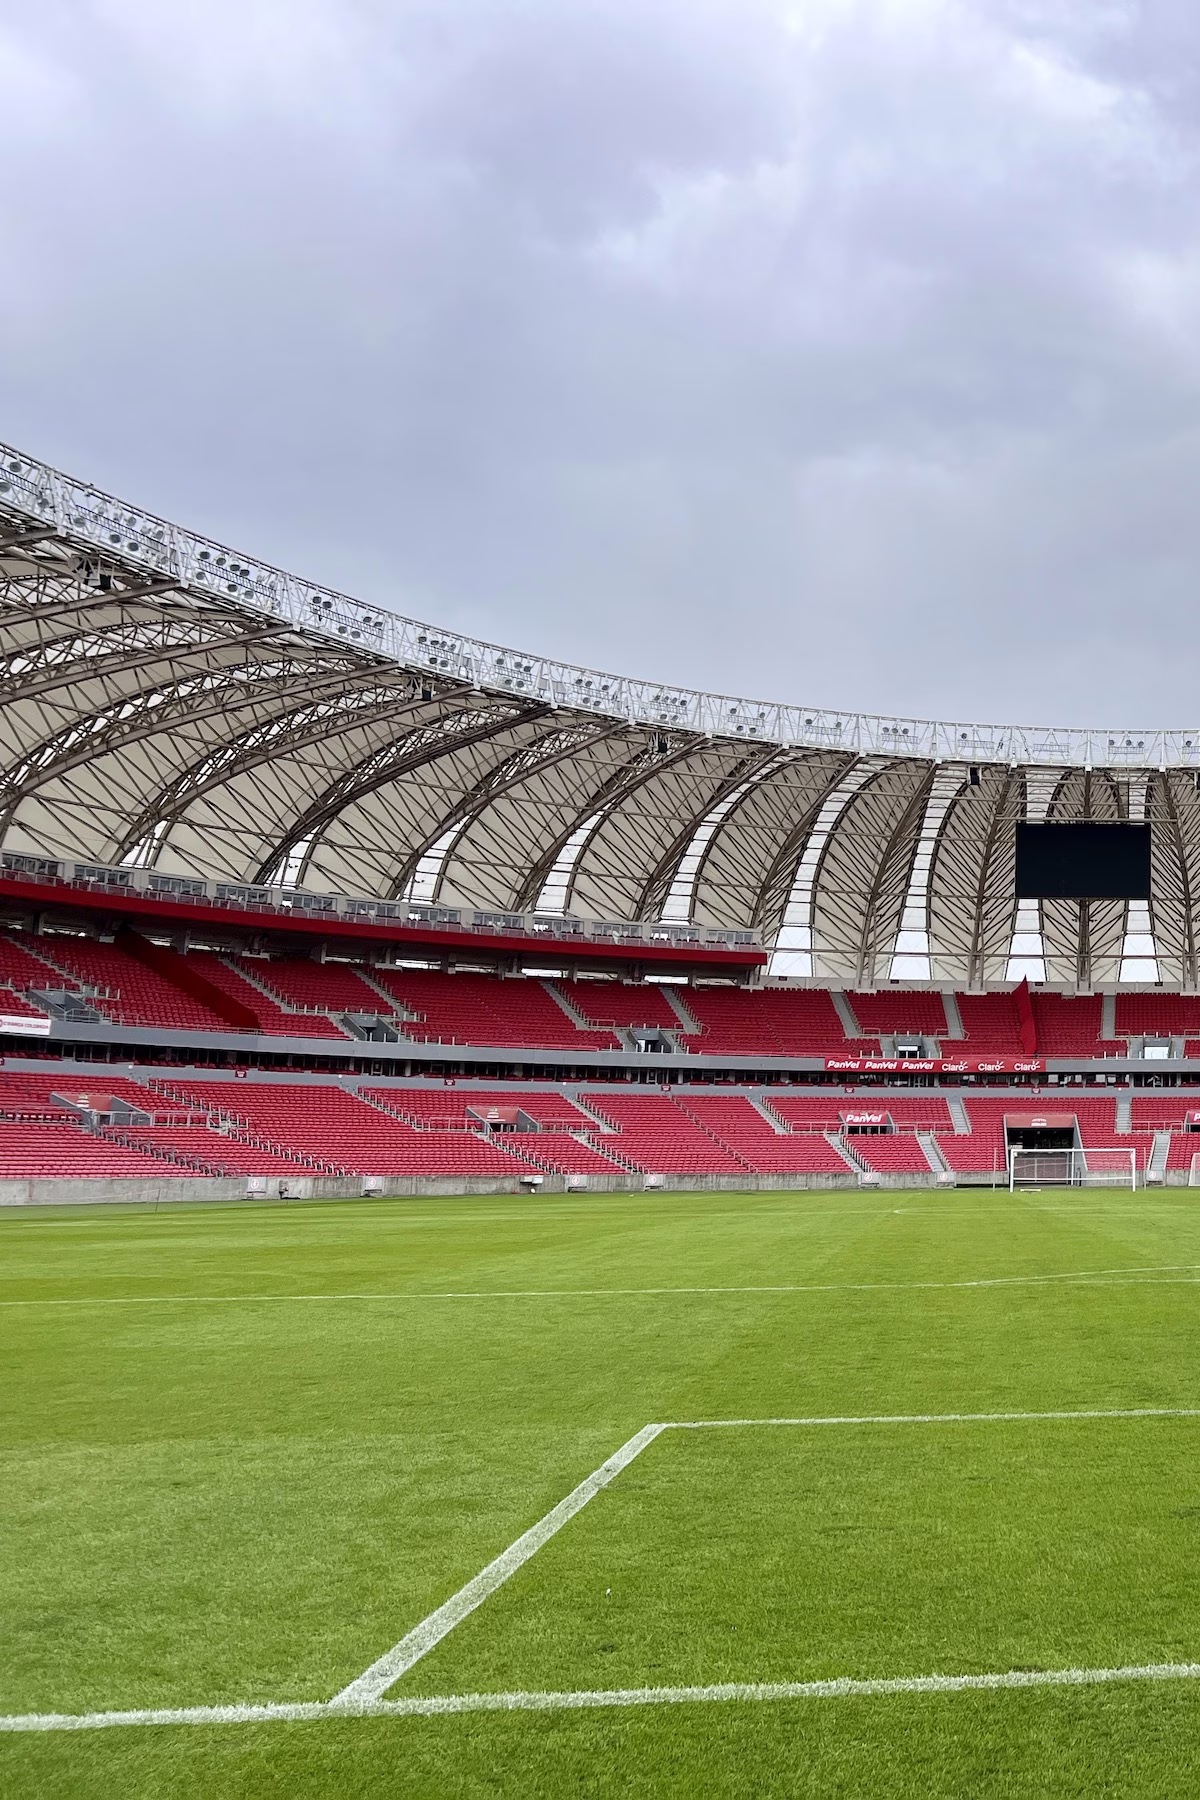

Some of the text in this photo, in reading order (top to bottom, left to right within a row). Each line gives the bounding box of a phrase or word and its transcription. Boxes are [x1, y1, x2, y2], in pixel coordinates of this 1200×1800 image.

[827, 1060, 1039, 1071] PanVel PanVel PanVel Claro Claro Claro
[846, 1113, 882, 1123] PanVel
